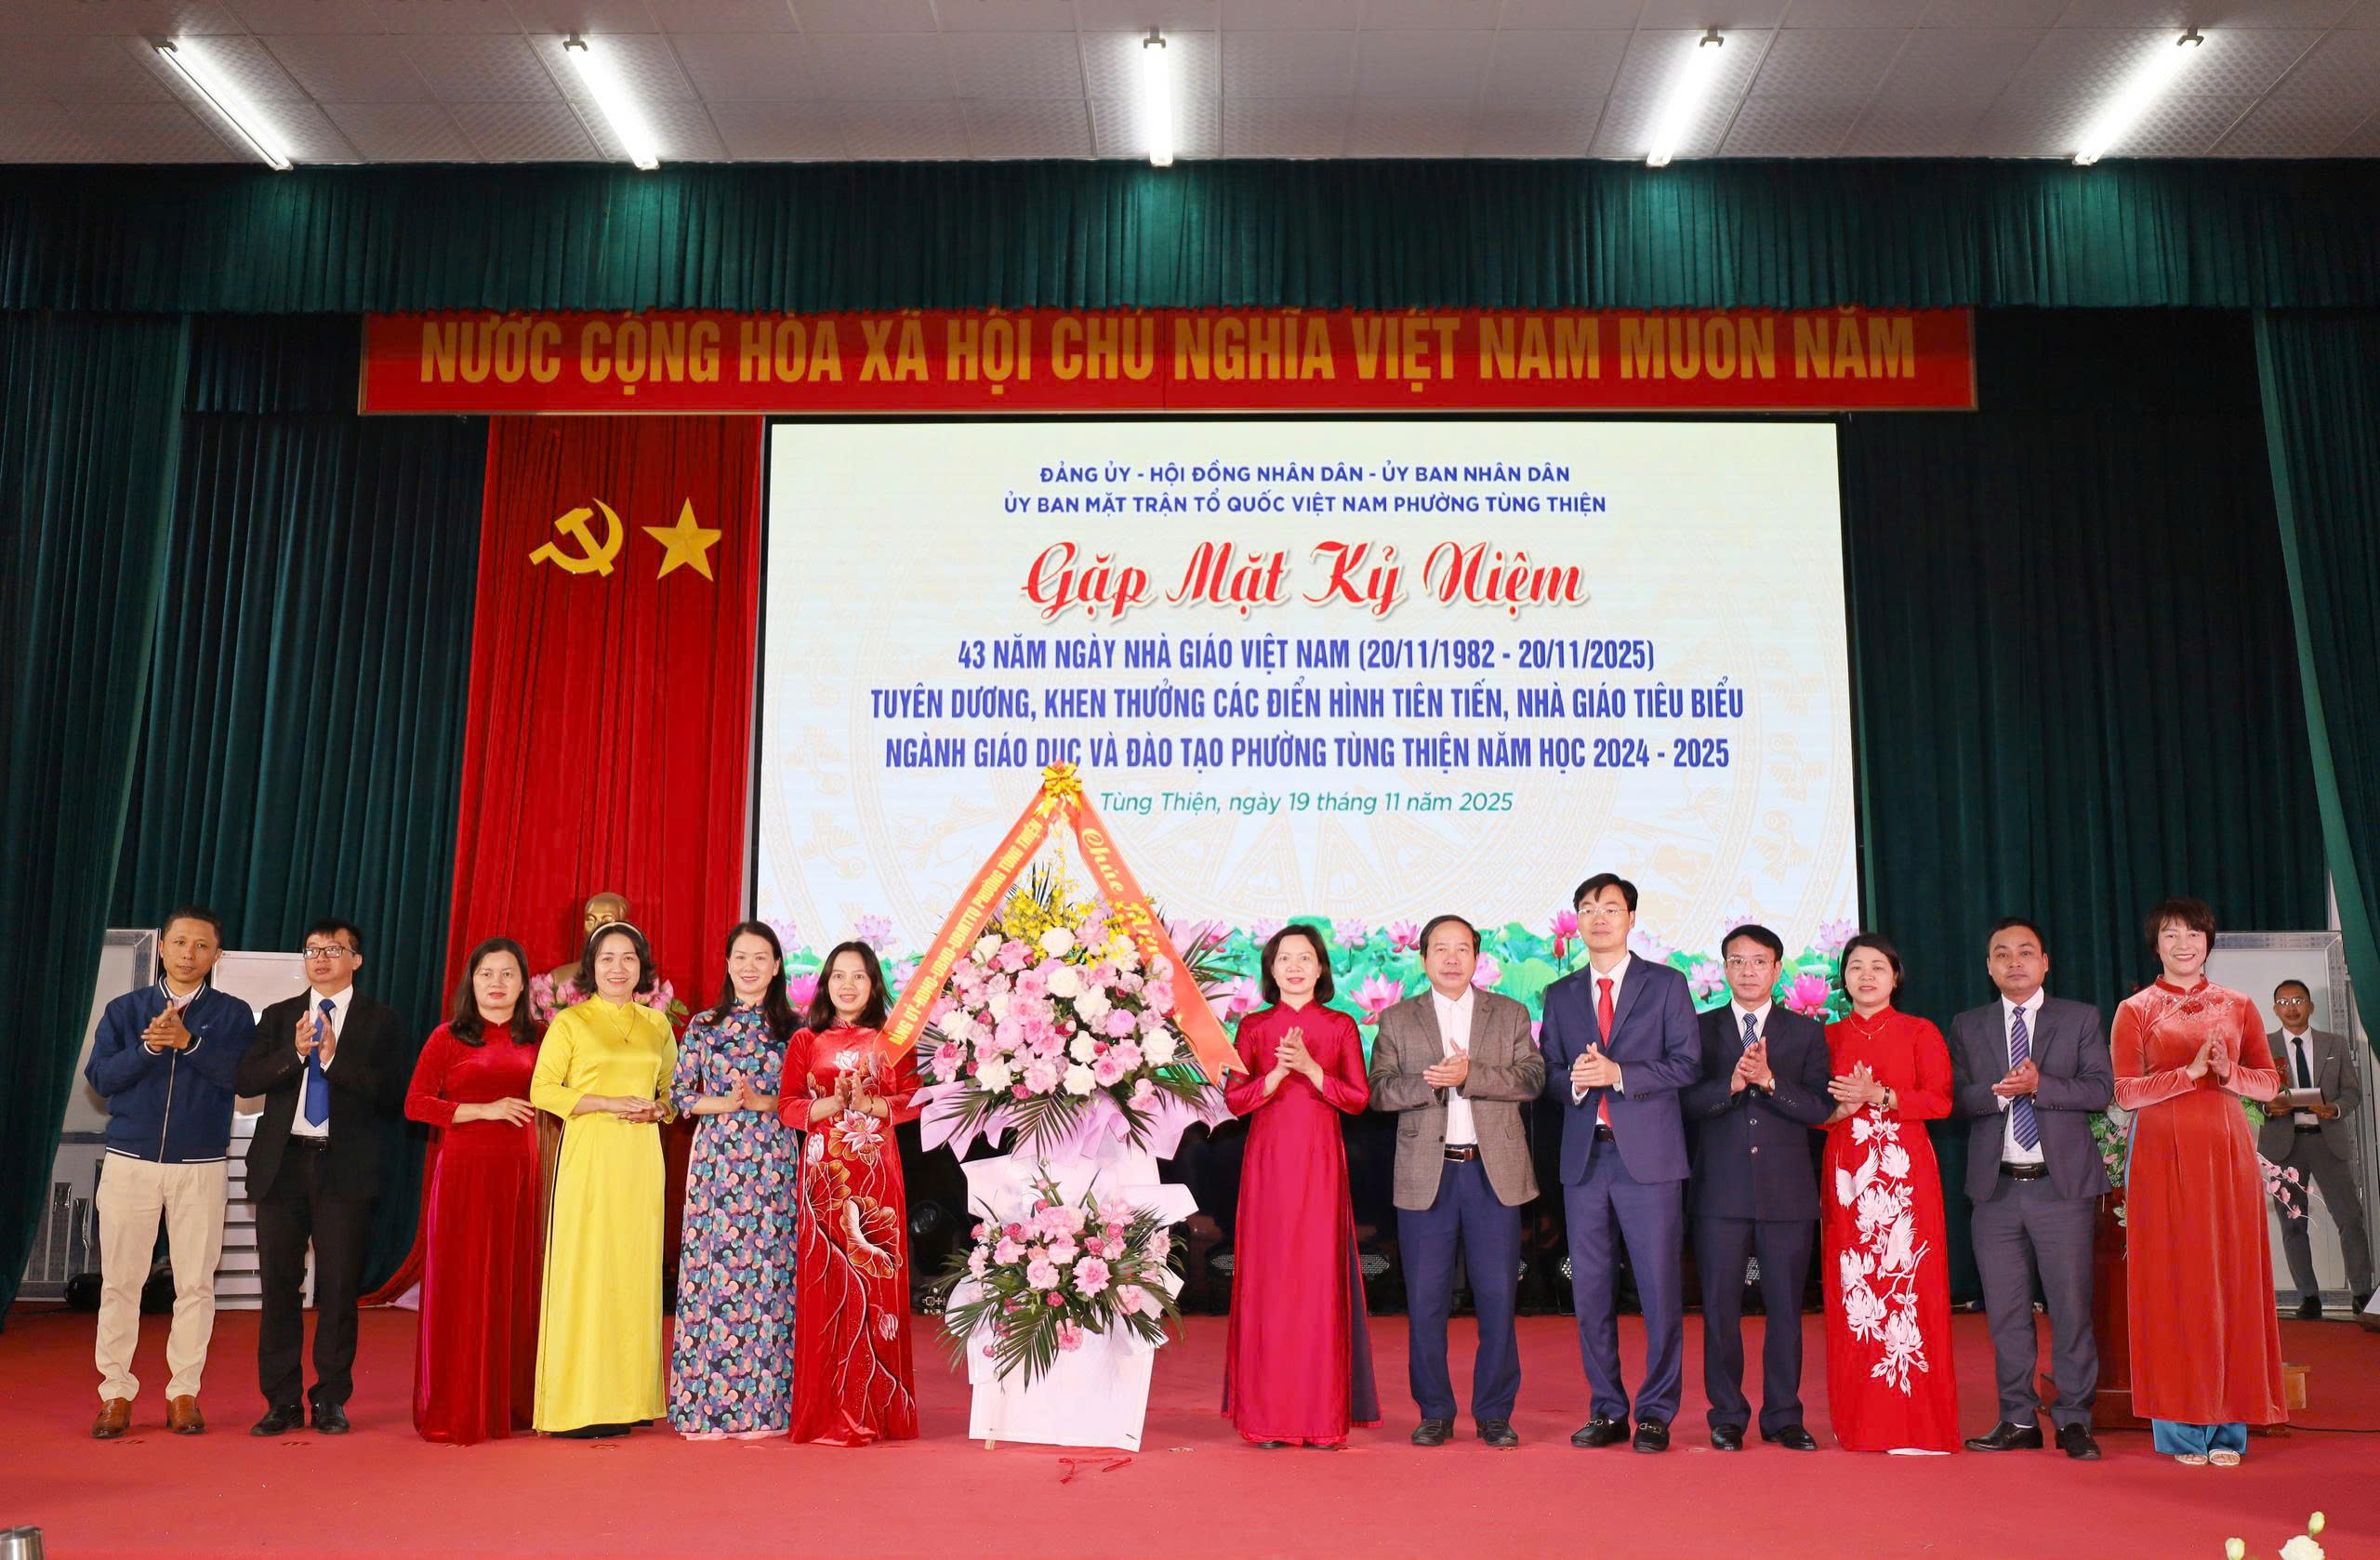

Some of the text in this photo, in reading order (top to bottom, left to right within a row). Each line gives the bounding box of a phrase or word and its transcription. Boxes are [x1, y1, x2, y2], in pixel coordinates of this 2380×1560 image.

[421, 313, 561, 383] NƯỚC
[580, 312, 720, 395] CỘNG
[739, 312, 843, 383] HÒA
[859, 310, 929, 382] XÃ
[946, 308, 1032, 395] HỘI
[1051, 309, 1155, 381] CHỦ
[1174, 309, 1337, 381] NGHĨA
[1351, 309, 1460, 392] VIỆT
[1479, 318, 1600, 379] NAM
[1795, 306, 1916, 378] NĂM
[1040, 461, 1098, 483] ĐẢNG
[1104, 461, 1131, 483] ỦY
[1150, 462, 1185, 486] HỘI
[1192, 460, 1250, 483] ĐỒNG
[1257, 462, 1314, 483] NHÂN
[1320, 462, 1363, 483] DÂN
[1382, 460, 1409, 483] ỦY
[1415, 467, 1457, 483] BAN
[1464, 462, 1521, 483] NHÂN
[1527, 462, 1570, 483] DÂN
[1004, 488, 1606, 516] ỦY BAN MẶT TRẬN TỔ QUỐC VIỆT NAM PHƯỜNG TÙNG THIỆN
[1021, 541, 1584, 619] Gặp Mặt Kỷ Niệm
[959, 639, 985, 669] 43
[994, 633, 1046, 669] NĂM
[1056, 633, 1117, 669] NGÀY
[1125, 633, 1171, 669] NHÀ
[1180, 633, 1233, 669] GIÁO
[1241, 632, 1288, 675] VIỆT
[1296, 639, 1350, 669] NAM
[1359, 639, 1495, 670] (20/11/1982
[1518, 639, 1655, 671] 20/11/2025)
[871, 675, 1744, 722] TUYÊN DƯƠNG, KHEN THƯỞNG CÁC ĐIỂN HÌNH TIÊN TIẾN, NHÀ GIÁO TIÊU BIỂU
[885, 732, 965, 768] NGÀNH
[973, 731, 1027, 768] GIÁO
[1091, 731, 1118, 767] VÀ
[1126, 731, 1172, 767] ĐÀO
[1182, 737, 1223, 774] TẠO
[1232, 730, 1327, 767] PHƯỜNG
[1334, 731, 1395, 767] TÙNG
[1402, 732, 1469, 774] THIỆN
[1477, 732, 1531, 767] NĂM
[1540, 737, 1585, 774] HỌC
[1593, 738, 1649, 768] 2024
[1673, 738, 1729, 768] 2025
[1101, 791, 1514, 815] Tùng Thiện, ngày 19 tháng 11 năm 2025
[972, 869, 1007, 909] PHƯỜNG
[997, 845, 1024, 873] TÙNG
[1015, 818, 1042, 849] THIỆN
[1081, 827, 1124, 894] Chúc
